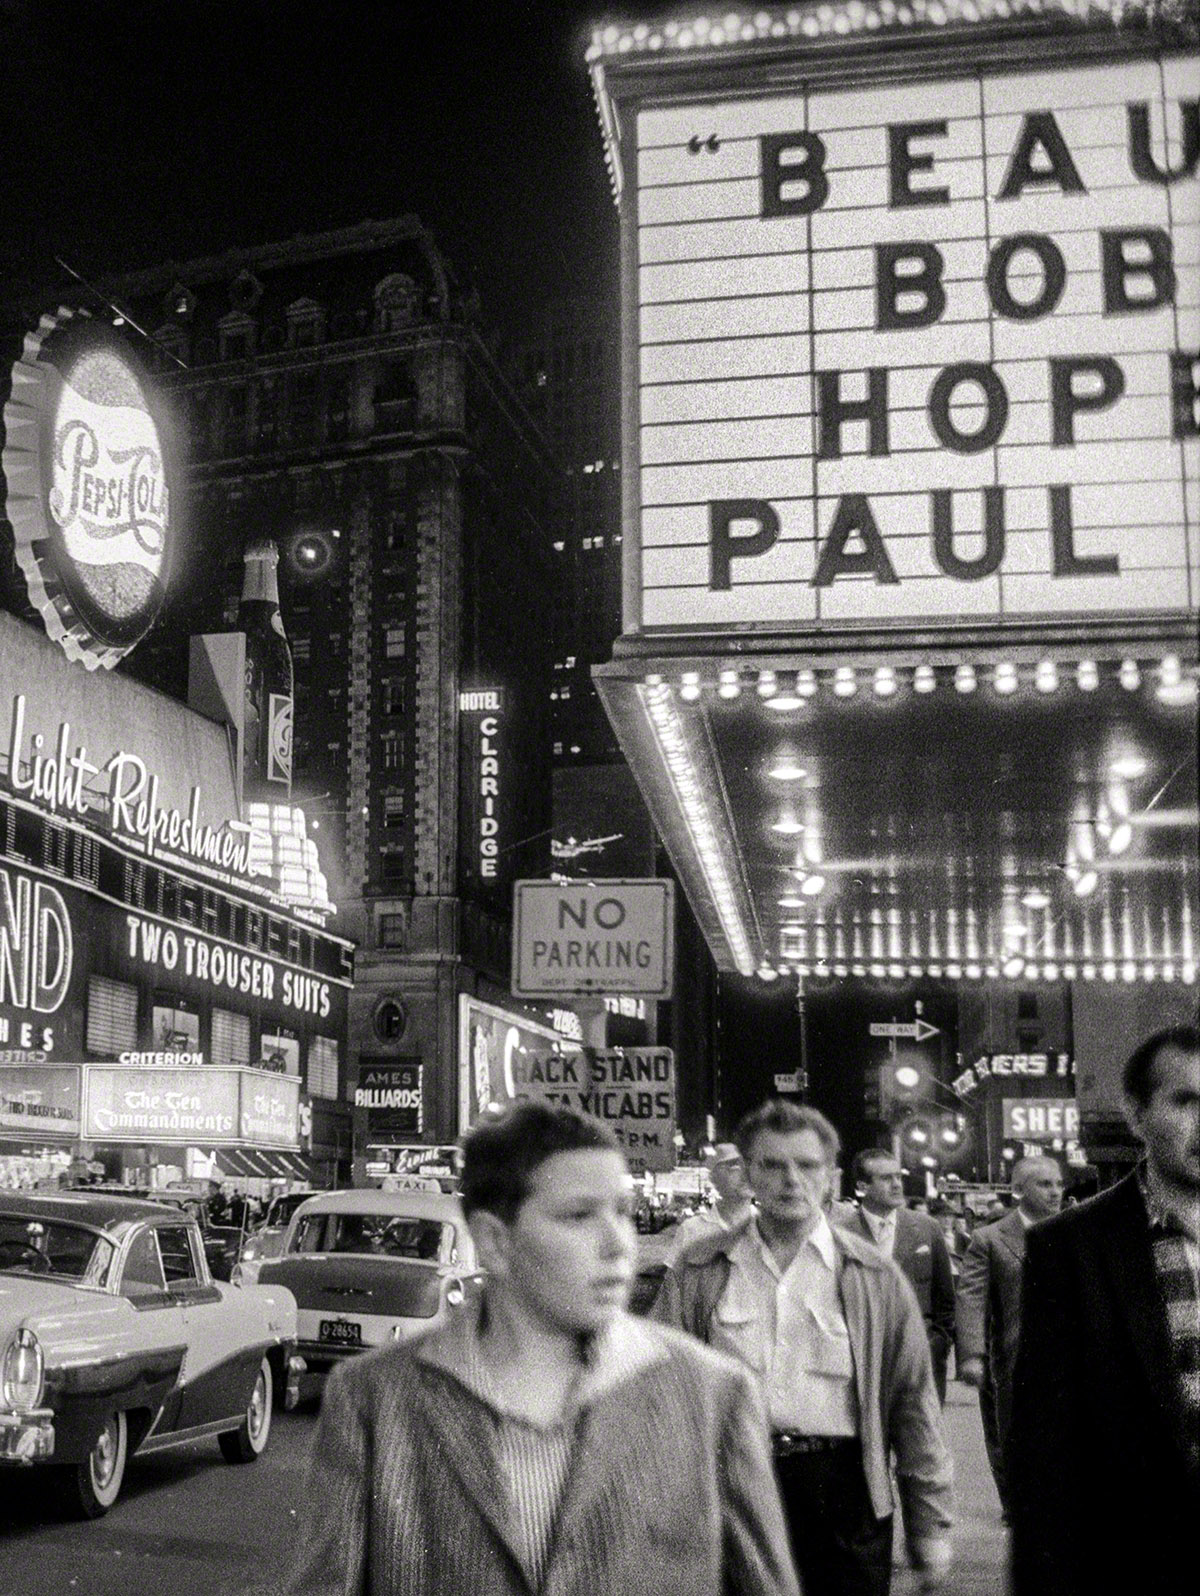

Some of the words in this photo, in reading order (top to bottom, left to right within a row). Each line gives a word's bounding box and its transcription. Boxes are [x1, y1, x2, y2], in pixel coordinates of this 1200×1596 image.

[874, 225, 1177, 331] BOB
[708, 484, 1120, 592] PAUL
[460, 692, 500, 711] HOTEL
[12, 695, 99, 813] Light
[109, 752, 274, 879] Refreshment
[480, 717, 498, 877] CLARIDGE
[559, 898, 626, 929] NO
[127, 915, 179, 970] TWO
[184, 937, 274, 1000] TROUSER
[283, 970, 331, 1018] SUITS
[533, 940, 650, 968] PARKING
[873, 1025, 892, 1034] ONE
[896, 1026, 914, 1035] WAY
[119, 1052, 202, 1065] CRITERION
[592, 1055, 670, 1083] STAND
[365, 1073, 412, 1085] AMES
[125, 1091, 160, 1109] The
[169, 1091, 202, 1109] Ten
[355, 1089, 420, 1108] BILLIARDS
[95, 1108, 233, 1132] Commandments
[395, 1180, 427, 1190] TAXI
